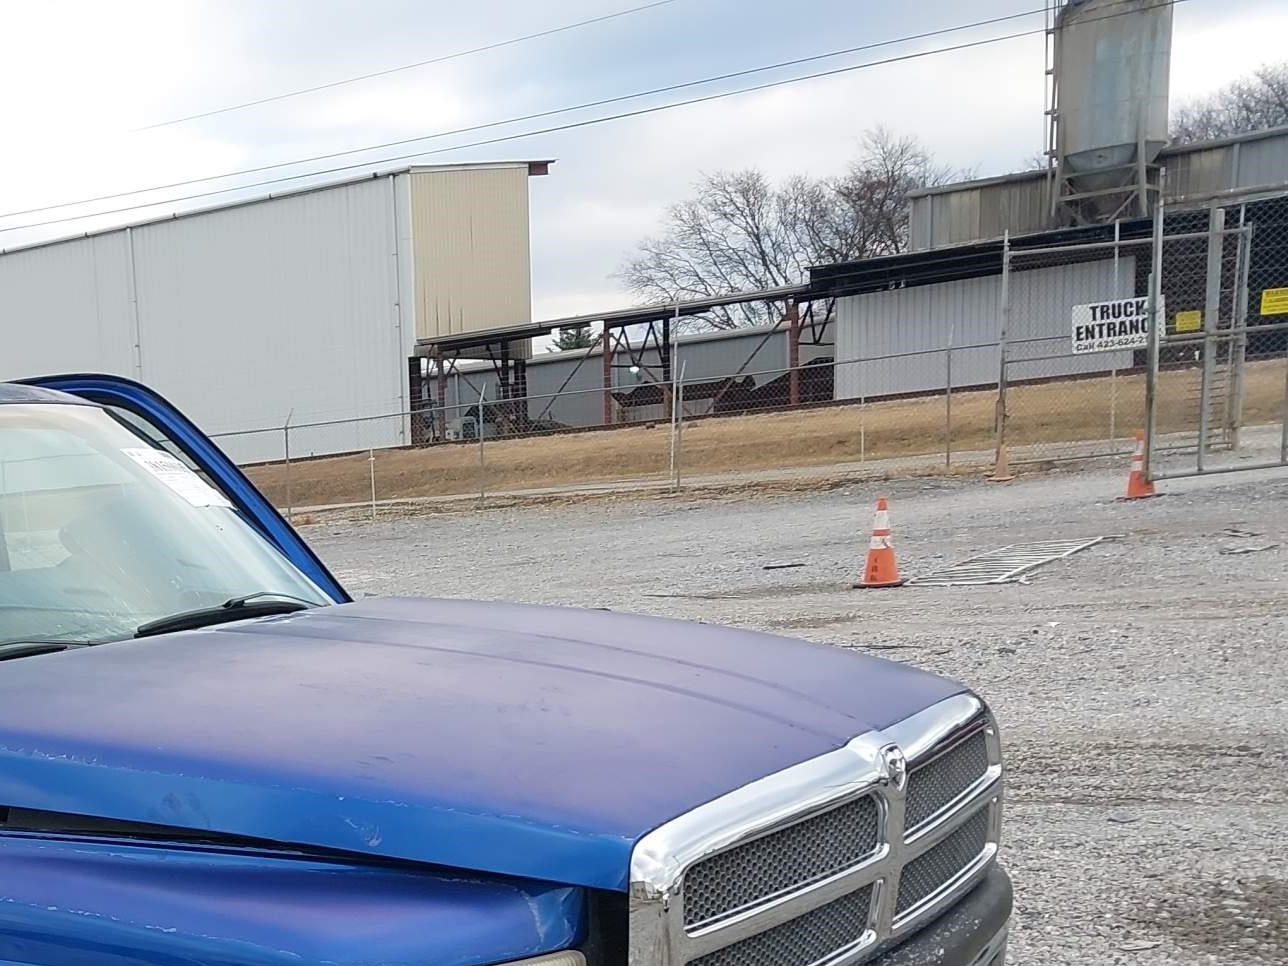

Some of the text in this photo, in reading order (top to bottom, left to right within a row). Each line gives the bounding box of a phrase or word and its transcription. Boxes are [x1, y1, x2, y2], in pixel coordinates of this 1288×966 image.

[1089, 299, 1146, 321] TRUCK
[1076, 317, 1149, 341] ENTRANC
[1076, 342, 1095, 351] Call
